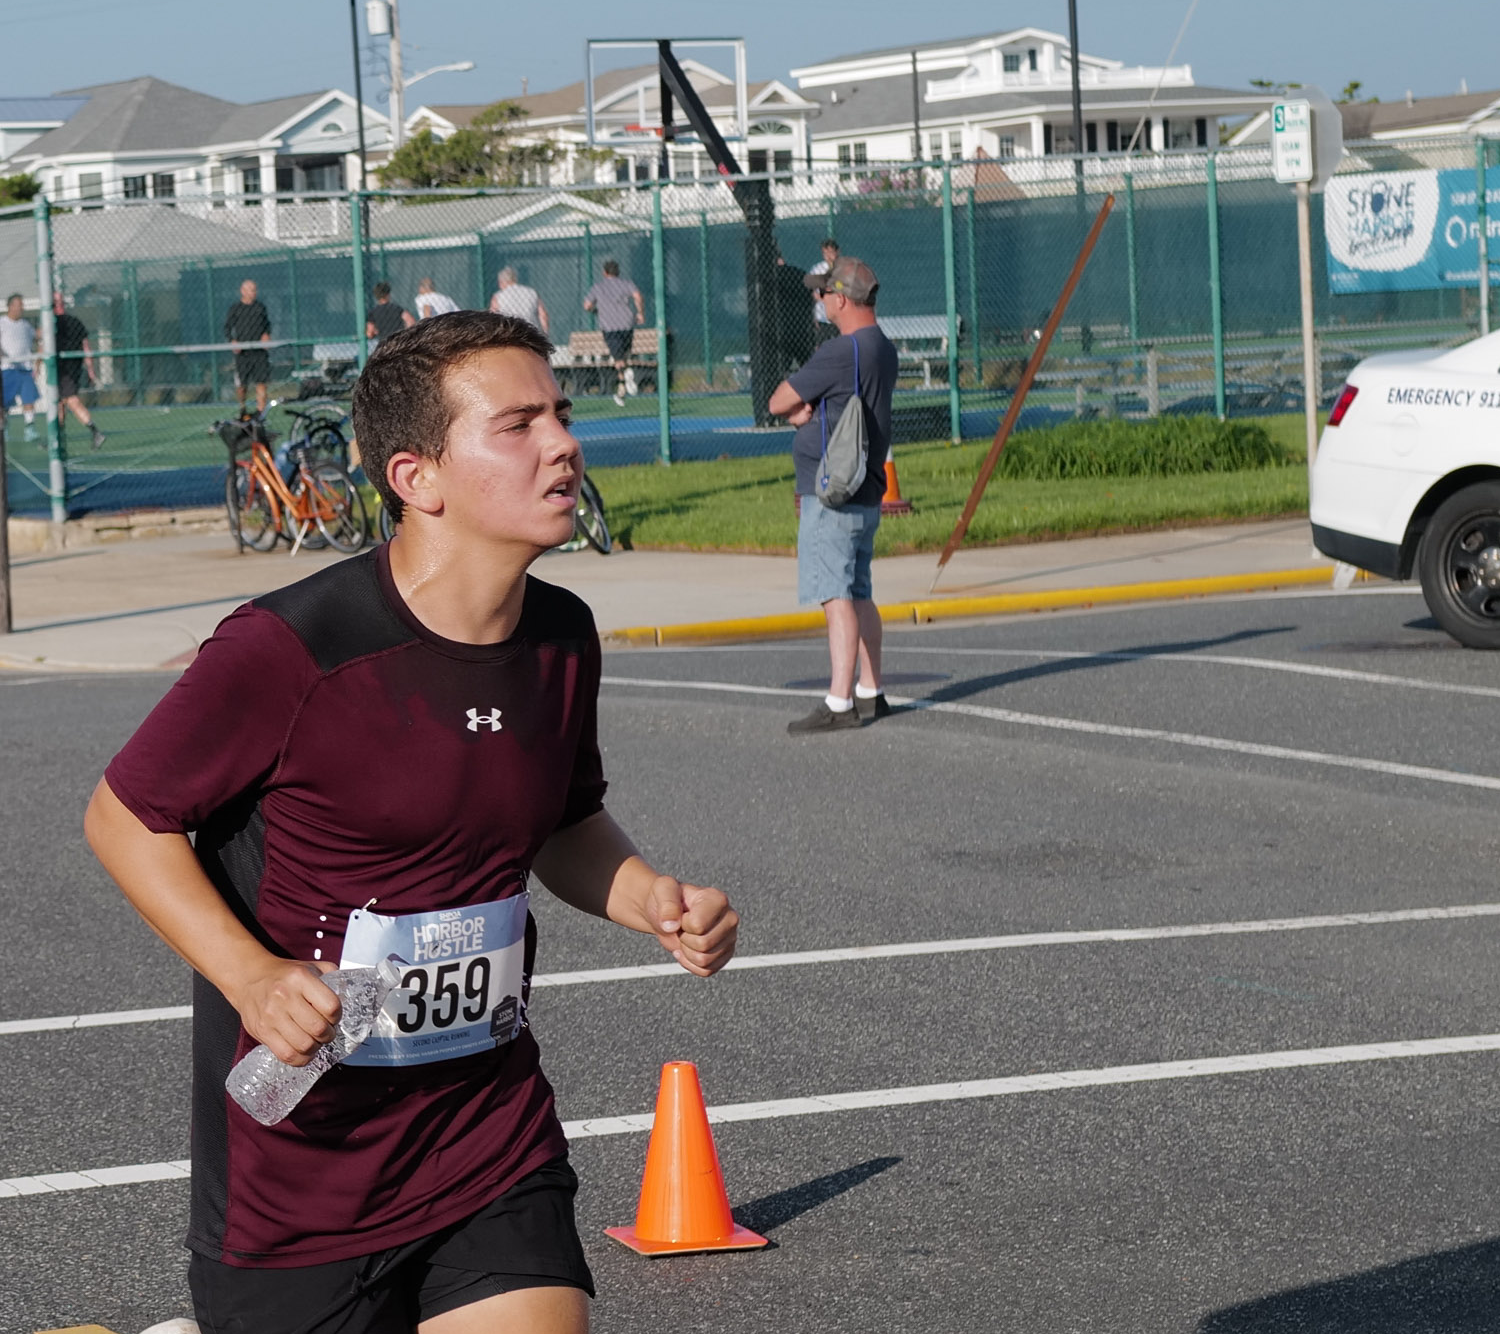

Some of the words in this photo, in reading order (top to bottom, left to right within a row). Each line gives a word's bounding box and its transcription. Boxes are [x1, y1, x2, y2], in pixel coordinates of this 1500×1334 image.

[1387, 387, 1475, 407] EMERGENCY
[412, 915, 486, 945] HARBOR
[413, 932, 484, 963] HUSTLE
[396, 956, 491, 1034] 359
